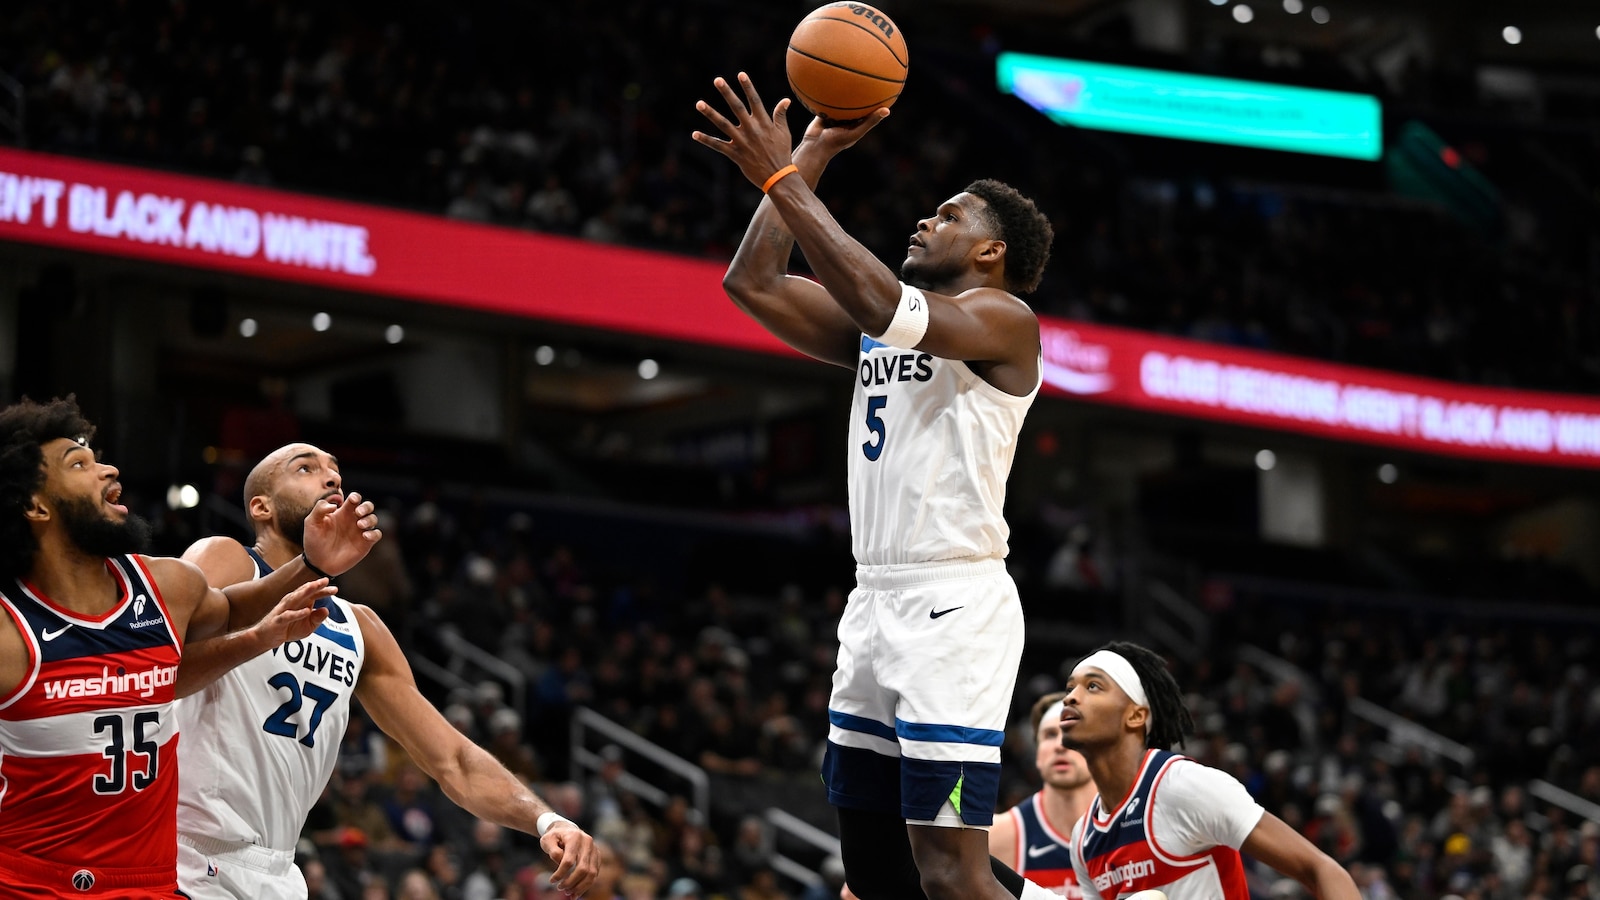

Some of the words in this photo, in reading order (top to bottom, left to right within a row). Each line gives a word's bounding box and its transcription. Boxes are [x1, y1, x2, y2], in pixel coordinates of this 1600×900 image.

[69, 183, 185, 246] BLACK
[186, 202, 260, 257] AND
[862, 395, 888, 462] 5
[1140, 352, 1220, 405] CLOUD
[1419, 396, 1496, 446] BLACK
[129, 616, 165, 630] Robinhood
[44, 665, 178, 699] washington
[263, 671, 339, 748] 27
[93, 710, 160, 795] 35
[1093, 859, 1156, 891] ashington
